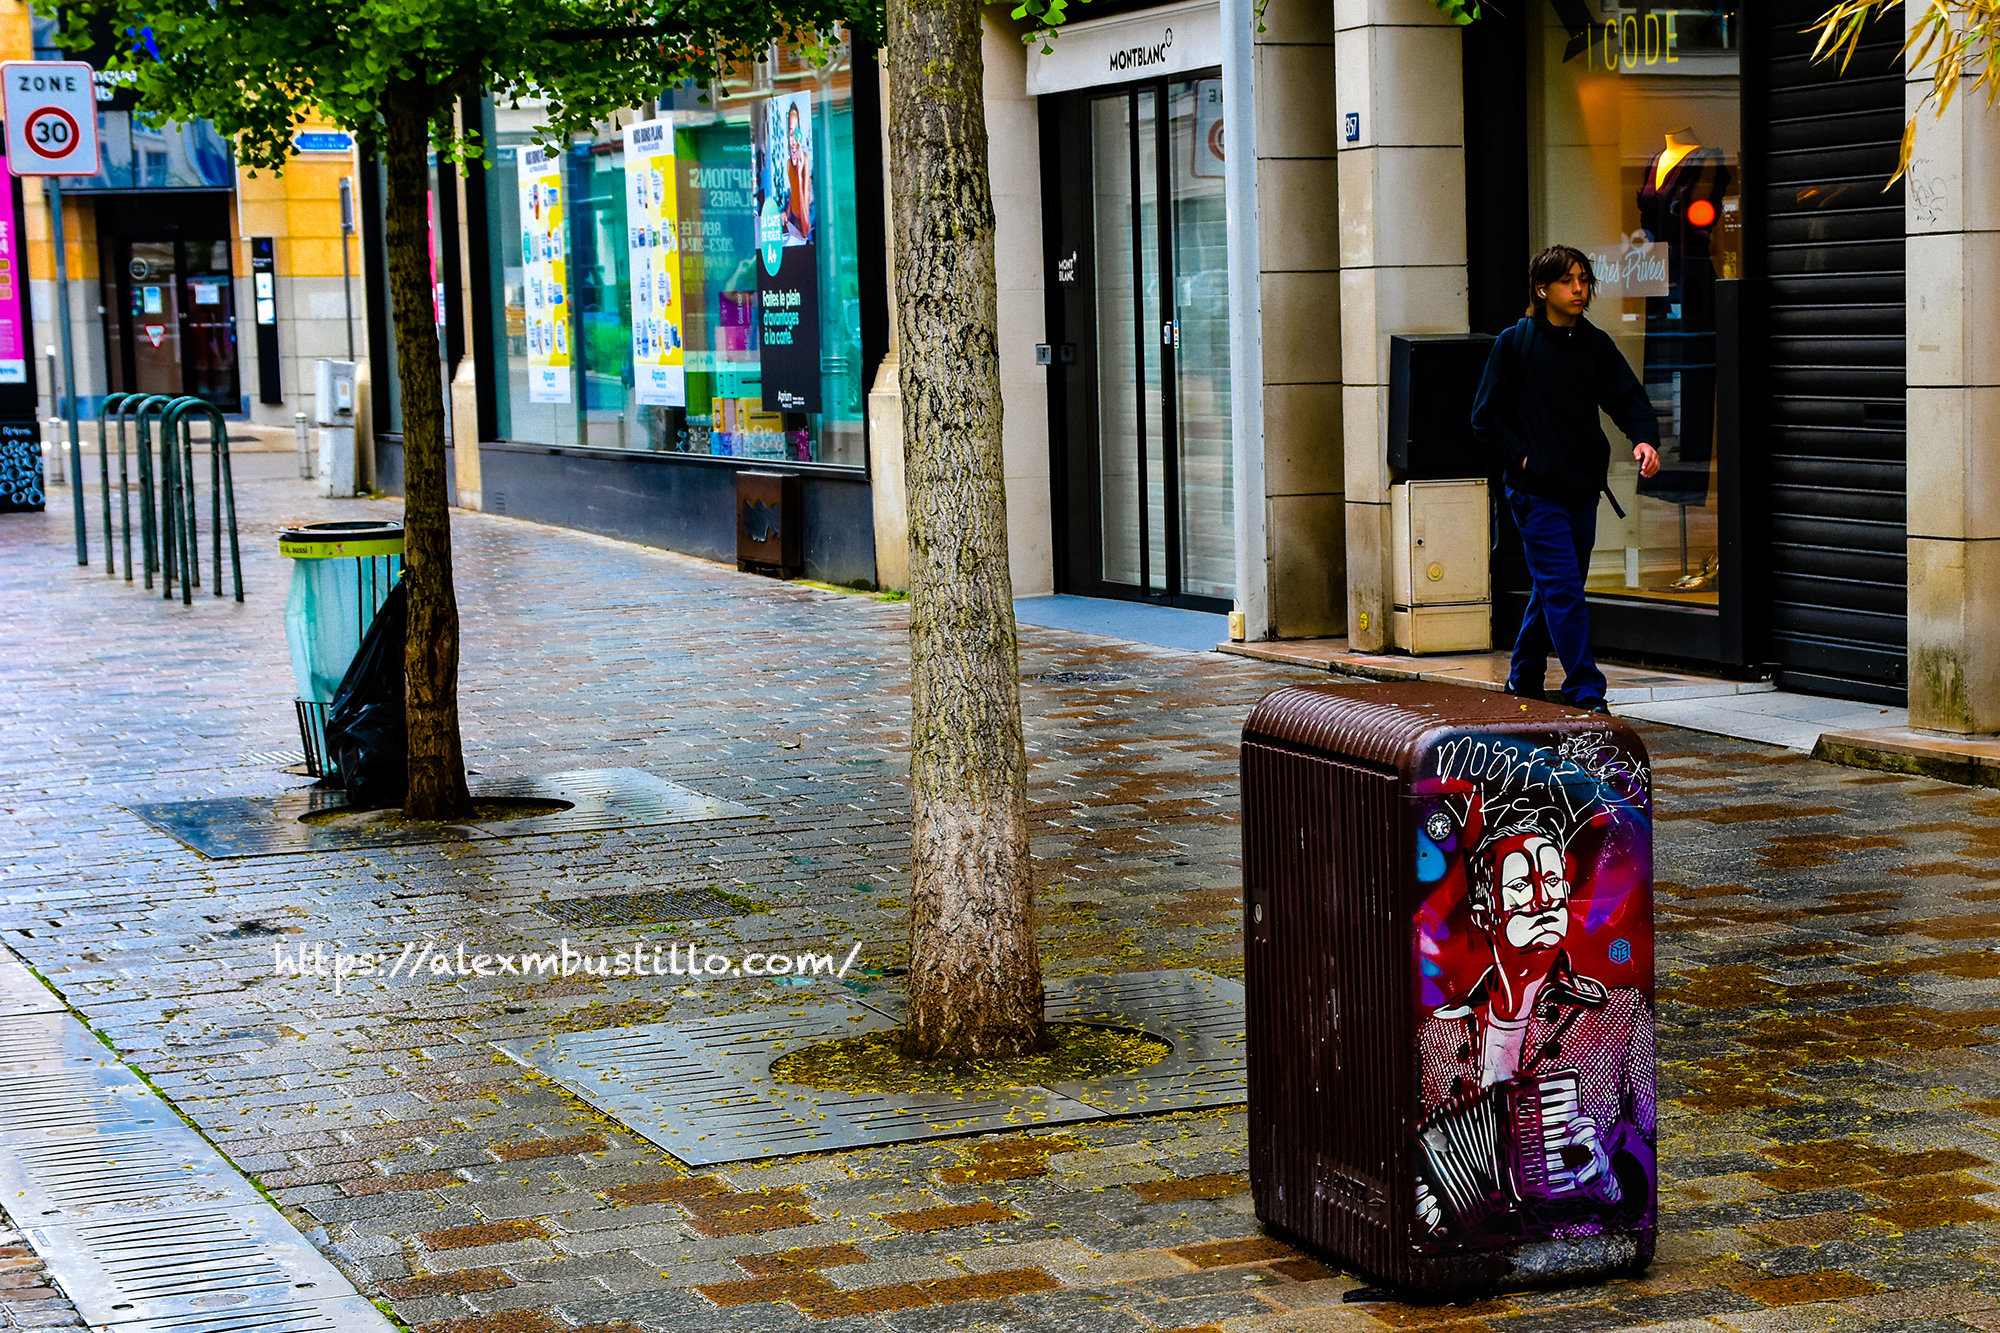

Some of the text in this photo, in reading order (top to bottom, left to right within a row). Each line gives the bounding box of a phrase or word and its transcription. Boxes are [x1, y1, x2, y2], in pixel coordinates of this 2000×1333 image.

[1604, 10, 1679, 71] CODE
[1109, 43, 1166, 71] MONTBLANC
[18, 76, 77, 92] ZONE
[35, 122, 68, 143] 30
[767, 243, 777, 264] A+
[1058, 259, 1073, 270] MONT
[1059, 270, 1074, 281] BLANC
[762, 288, 801, 309] Faites le plein
[764, 309, 800, 330] d'avantages
[764, 328, 794, 345] à la carte.
[778, 390, 792, 404] Aprium
